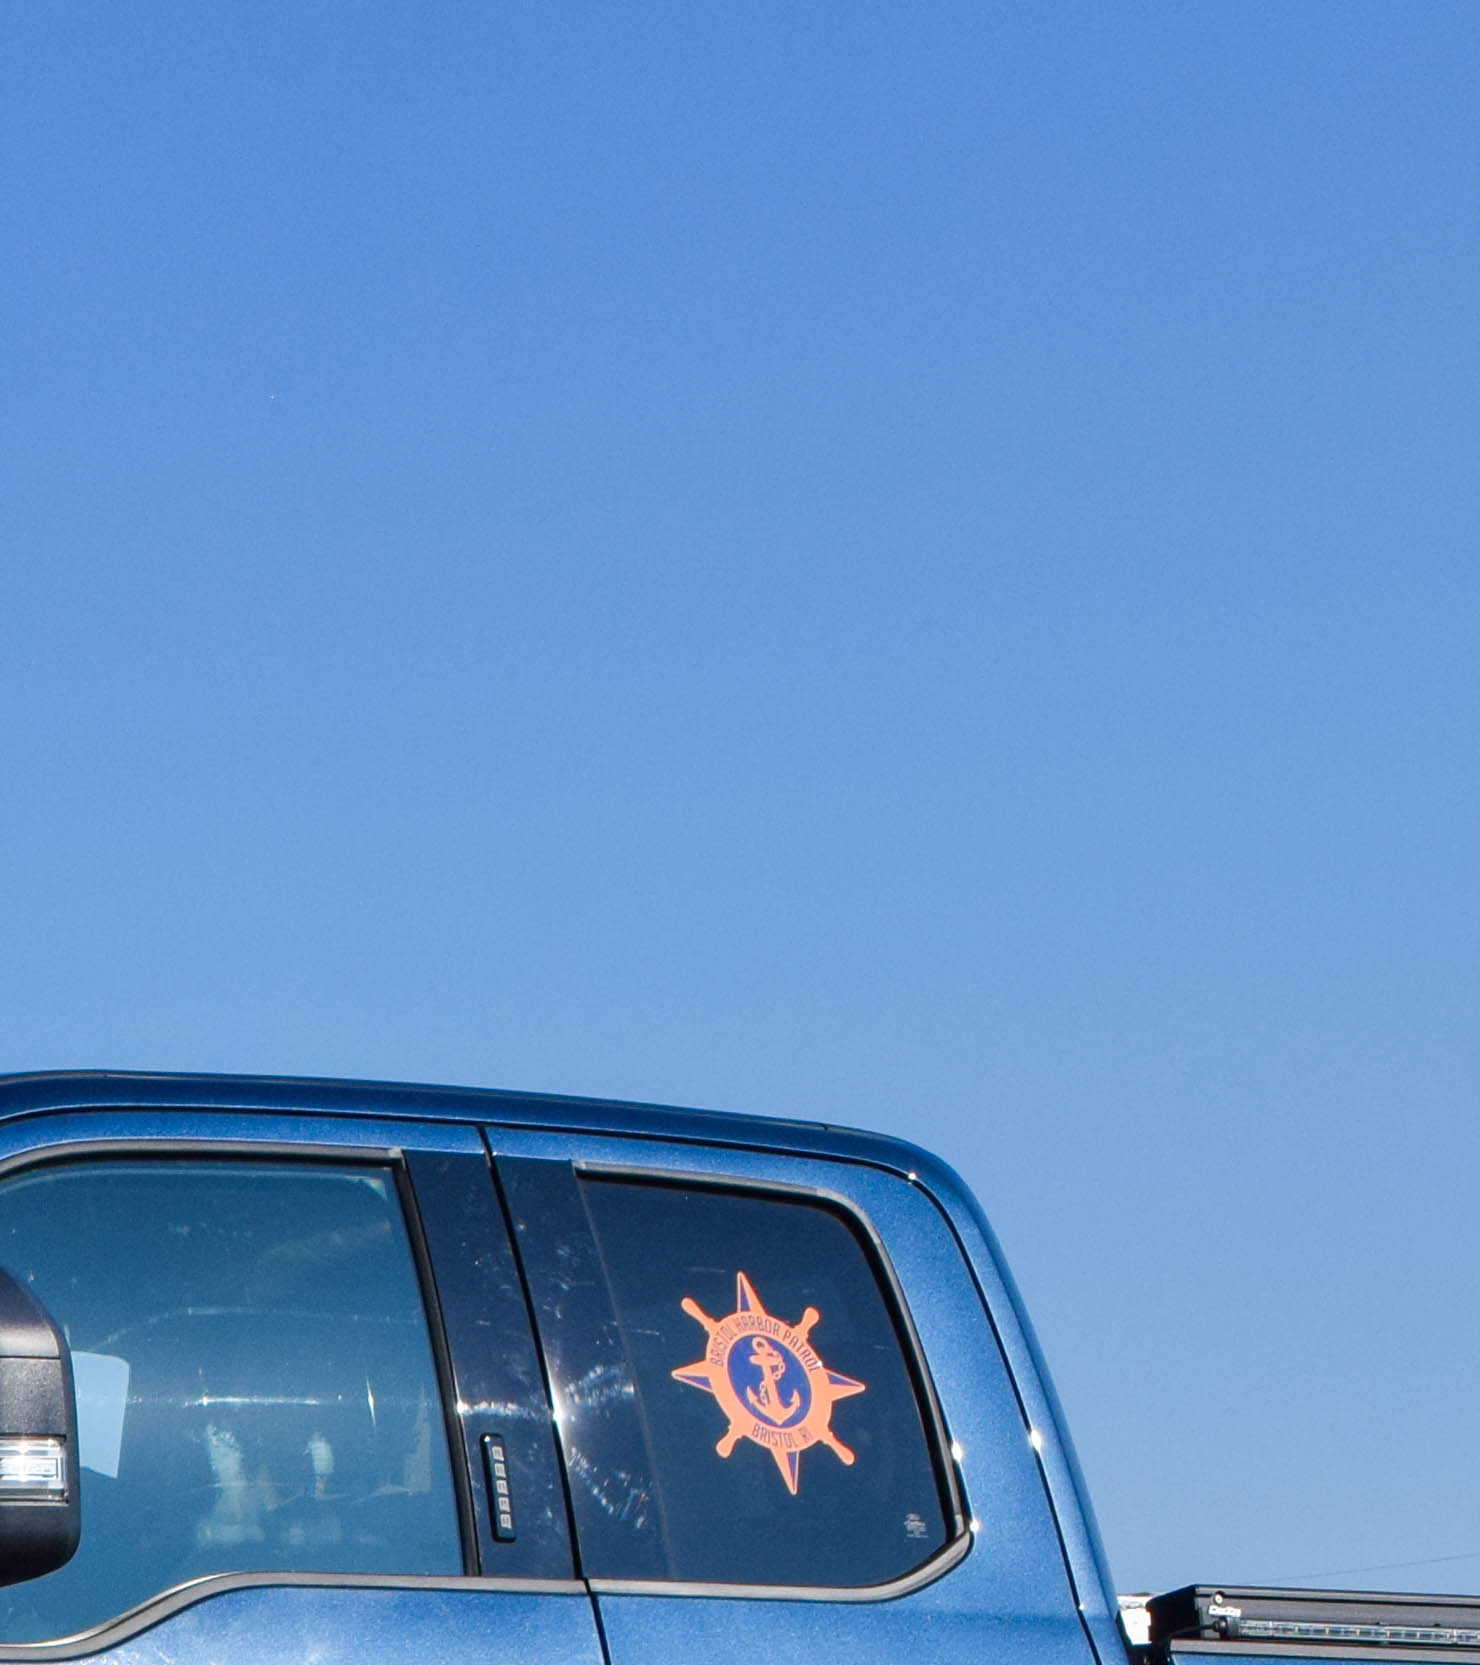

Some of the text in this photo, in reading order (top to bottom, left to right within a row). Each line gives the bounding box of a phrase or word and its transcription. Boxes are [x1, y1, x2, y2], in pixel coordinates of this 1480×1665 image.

[710, 1314, 822, 1374] BRISTOL HARBOR PATROL
[752, 1423, 798, 1449] BRISTOL
